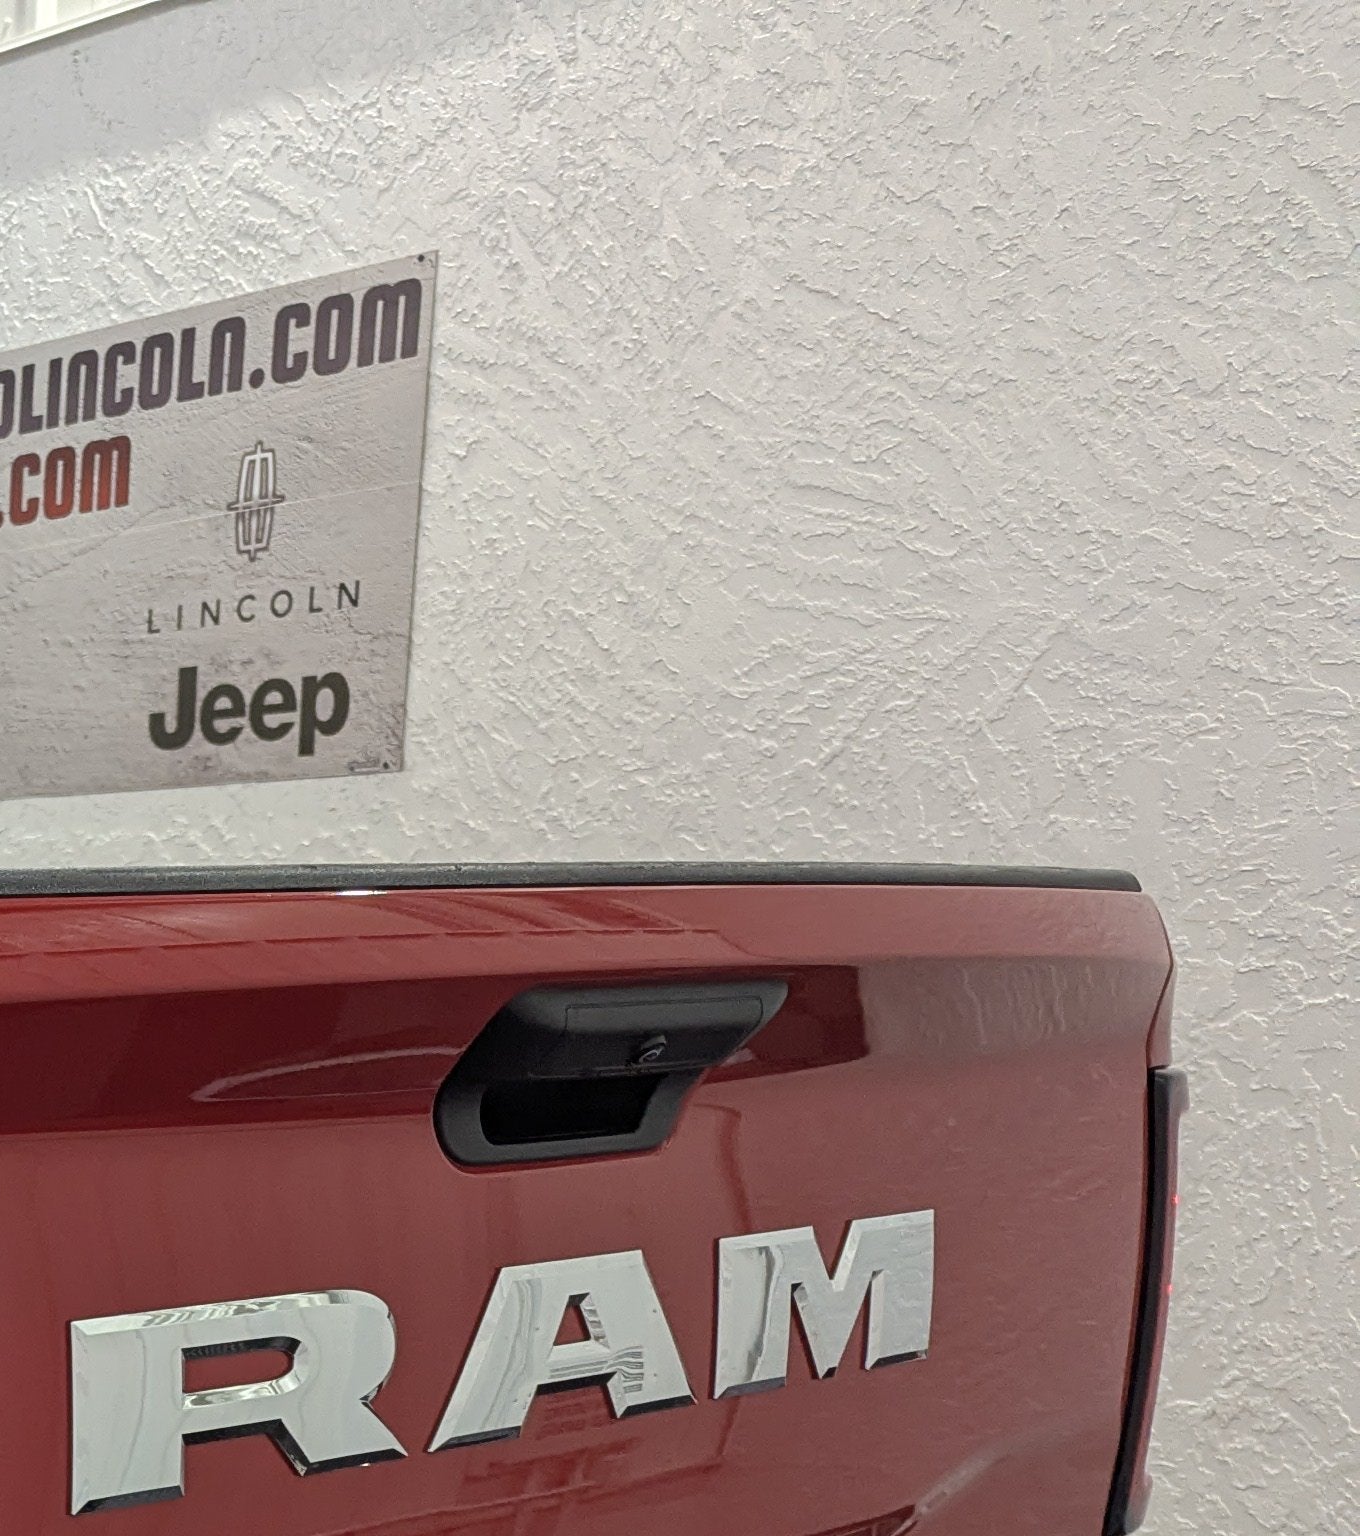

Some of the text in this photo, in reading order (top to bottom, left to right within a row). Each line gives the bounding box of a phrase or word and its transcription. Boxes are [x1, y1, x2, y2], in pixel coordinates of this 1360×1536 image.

[147, 580, 360, 634] LINCOLN
[149, 666, 350, 757] Jeep
[70, 1208, 934, 1516] RAM
